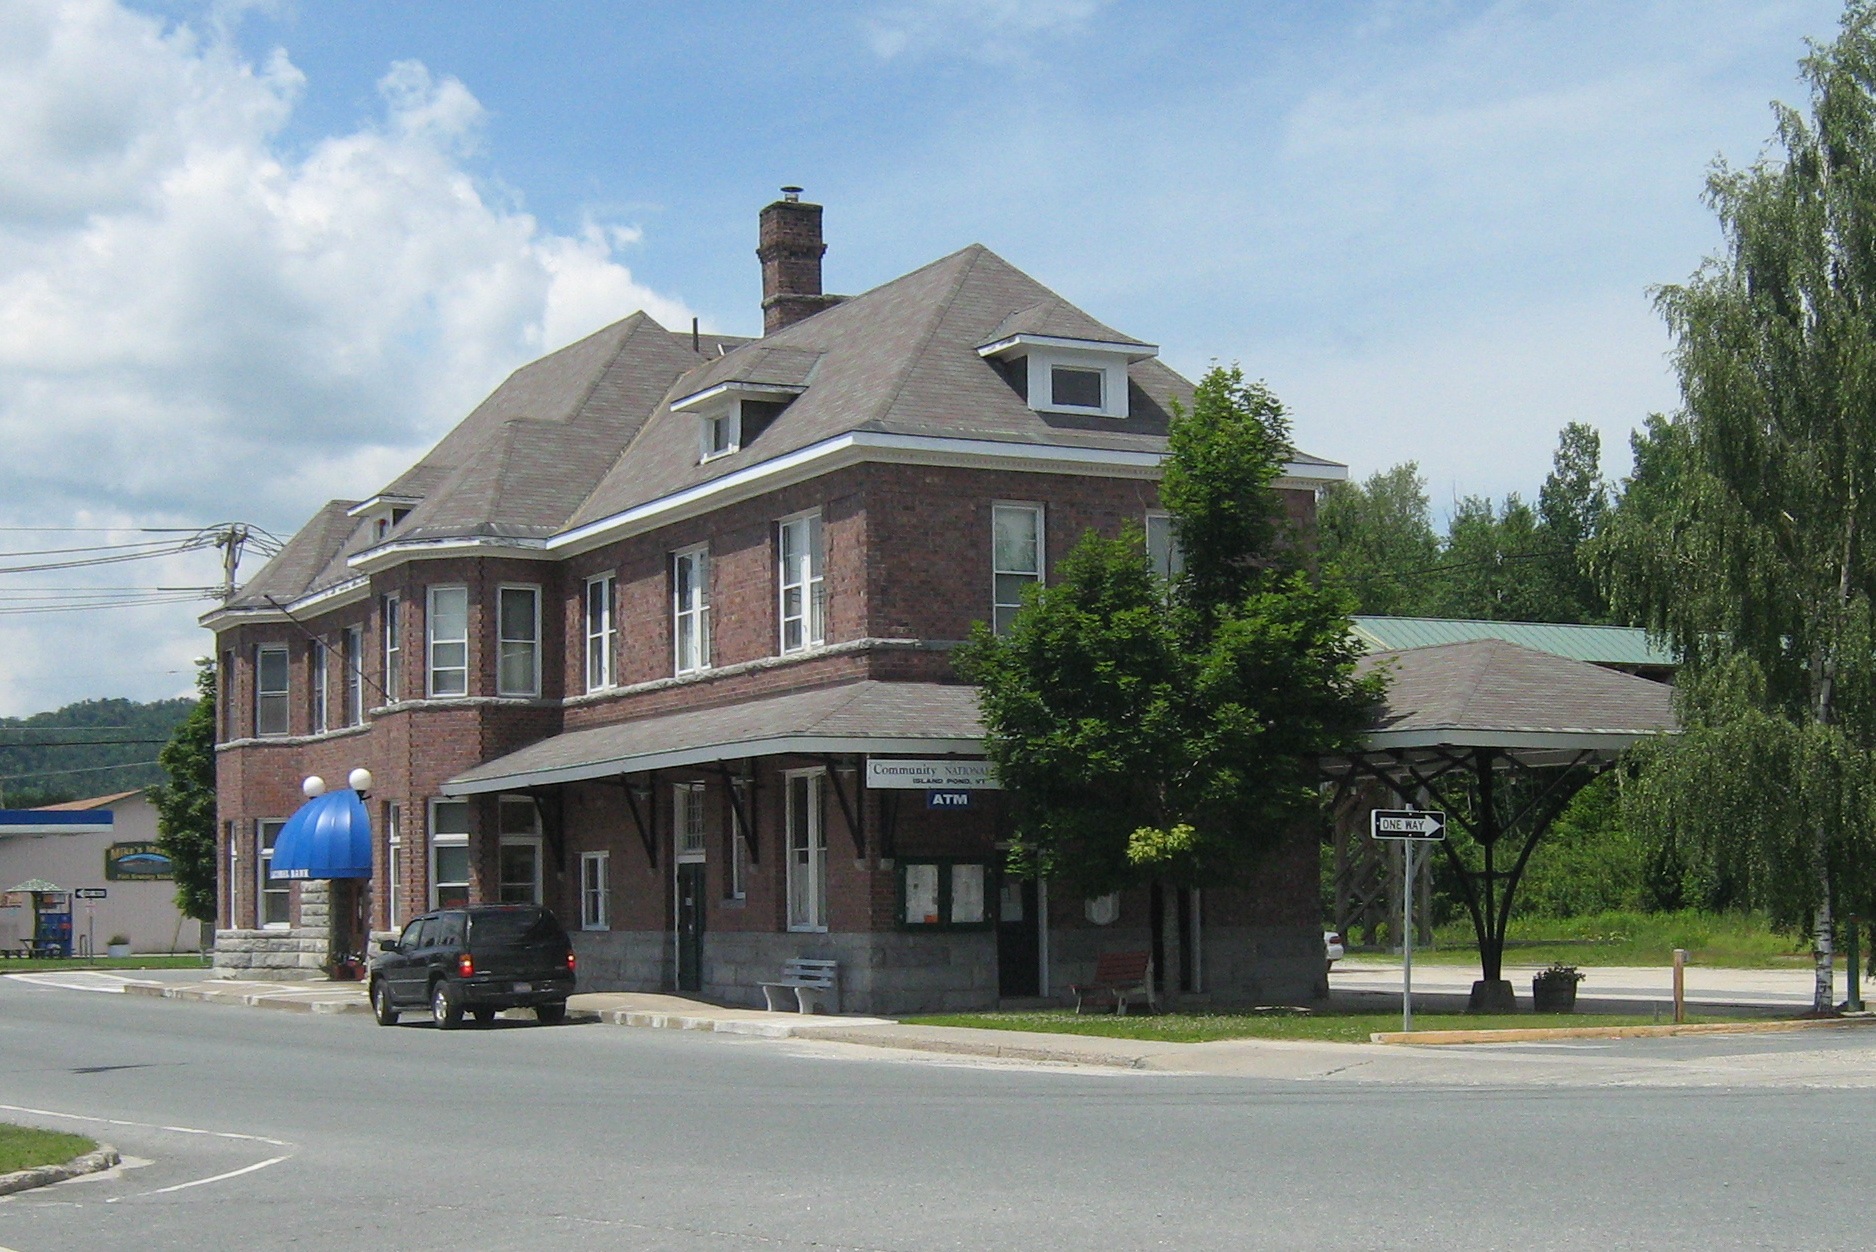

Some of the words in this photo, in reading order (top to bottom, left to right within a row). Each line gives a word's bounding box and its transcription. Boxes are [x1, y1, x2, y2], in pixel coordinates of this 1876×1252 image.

[873, 764, 937, 777] Community
[932, 794, 968, 805] ATM
[1382, 819, 1402, 830] ONE
[1405, 819, 1424, 831] WAY
